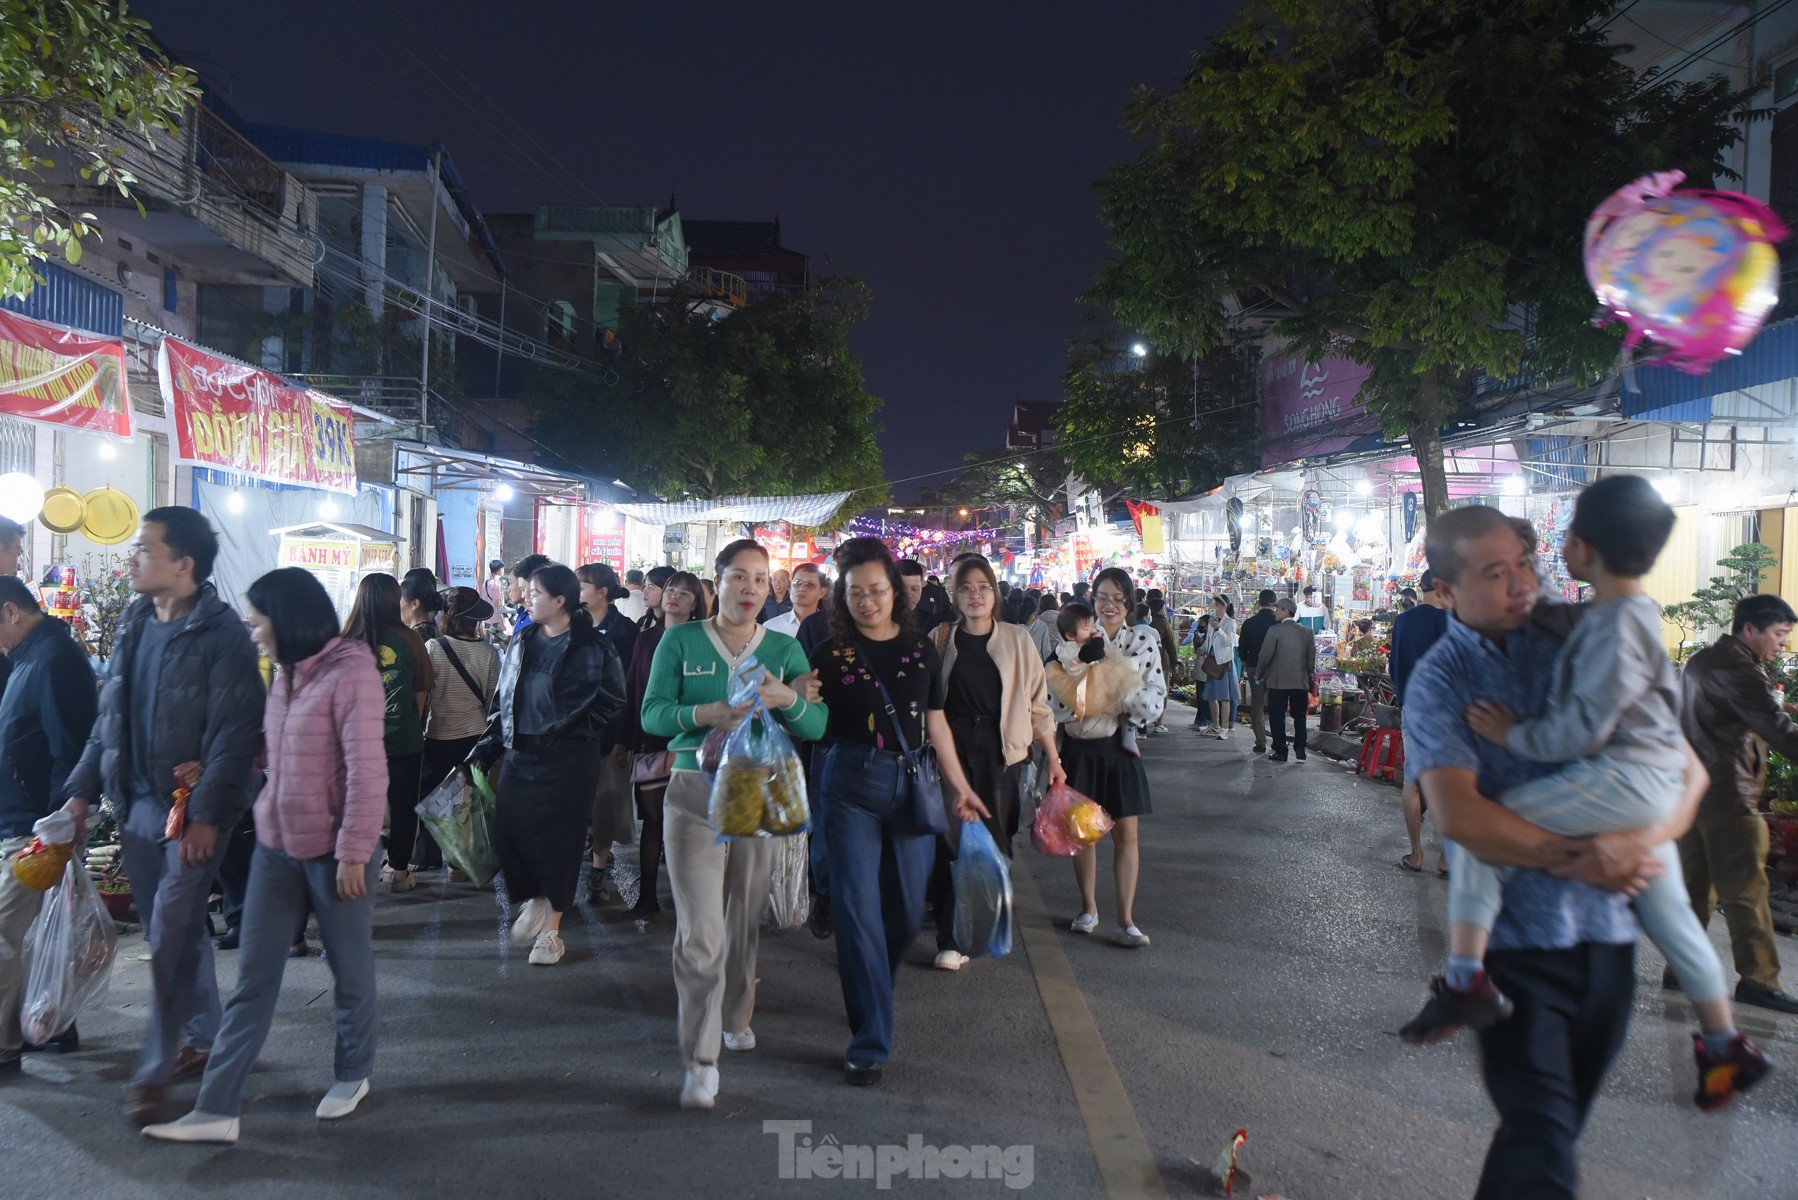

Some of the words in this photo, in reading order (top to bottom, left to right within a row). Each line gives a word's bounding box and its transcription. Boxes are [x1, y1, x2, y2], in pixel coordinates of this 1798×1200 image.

[192, 398, 261, 466] ĐỒNG
[267, 399, 306, 477] GIÁ
[314, 412, 352, 467] 39K
[289, 543, 327, 564] BÁNH
